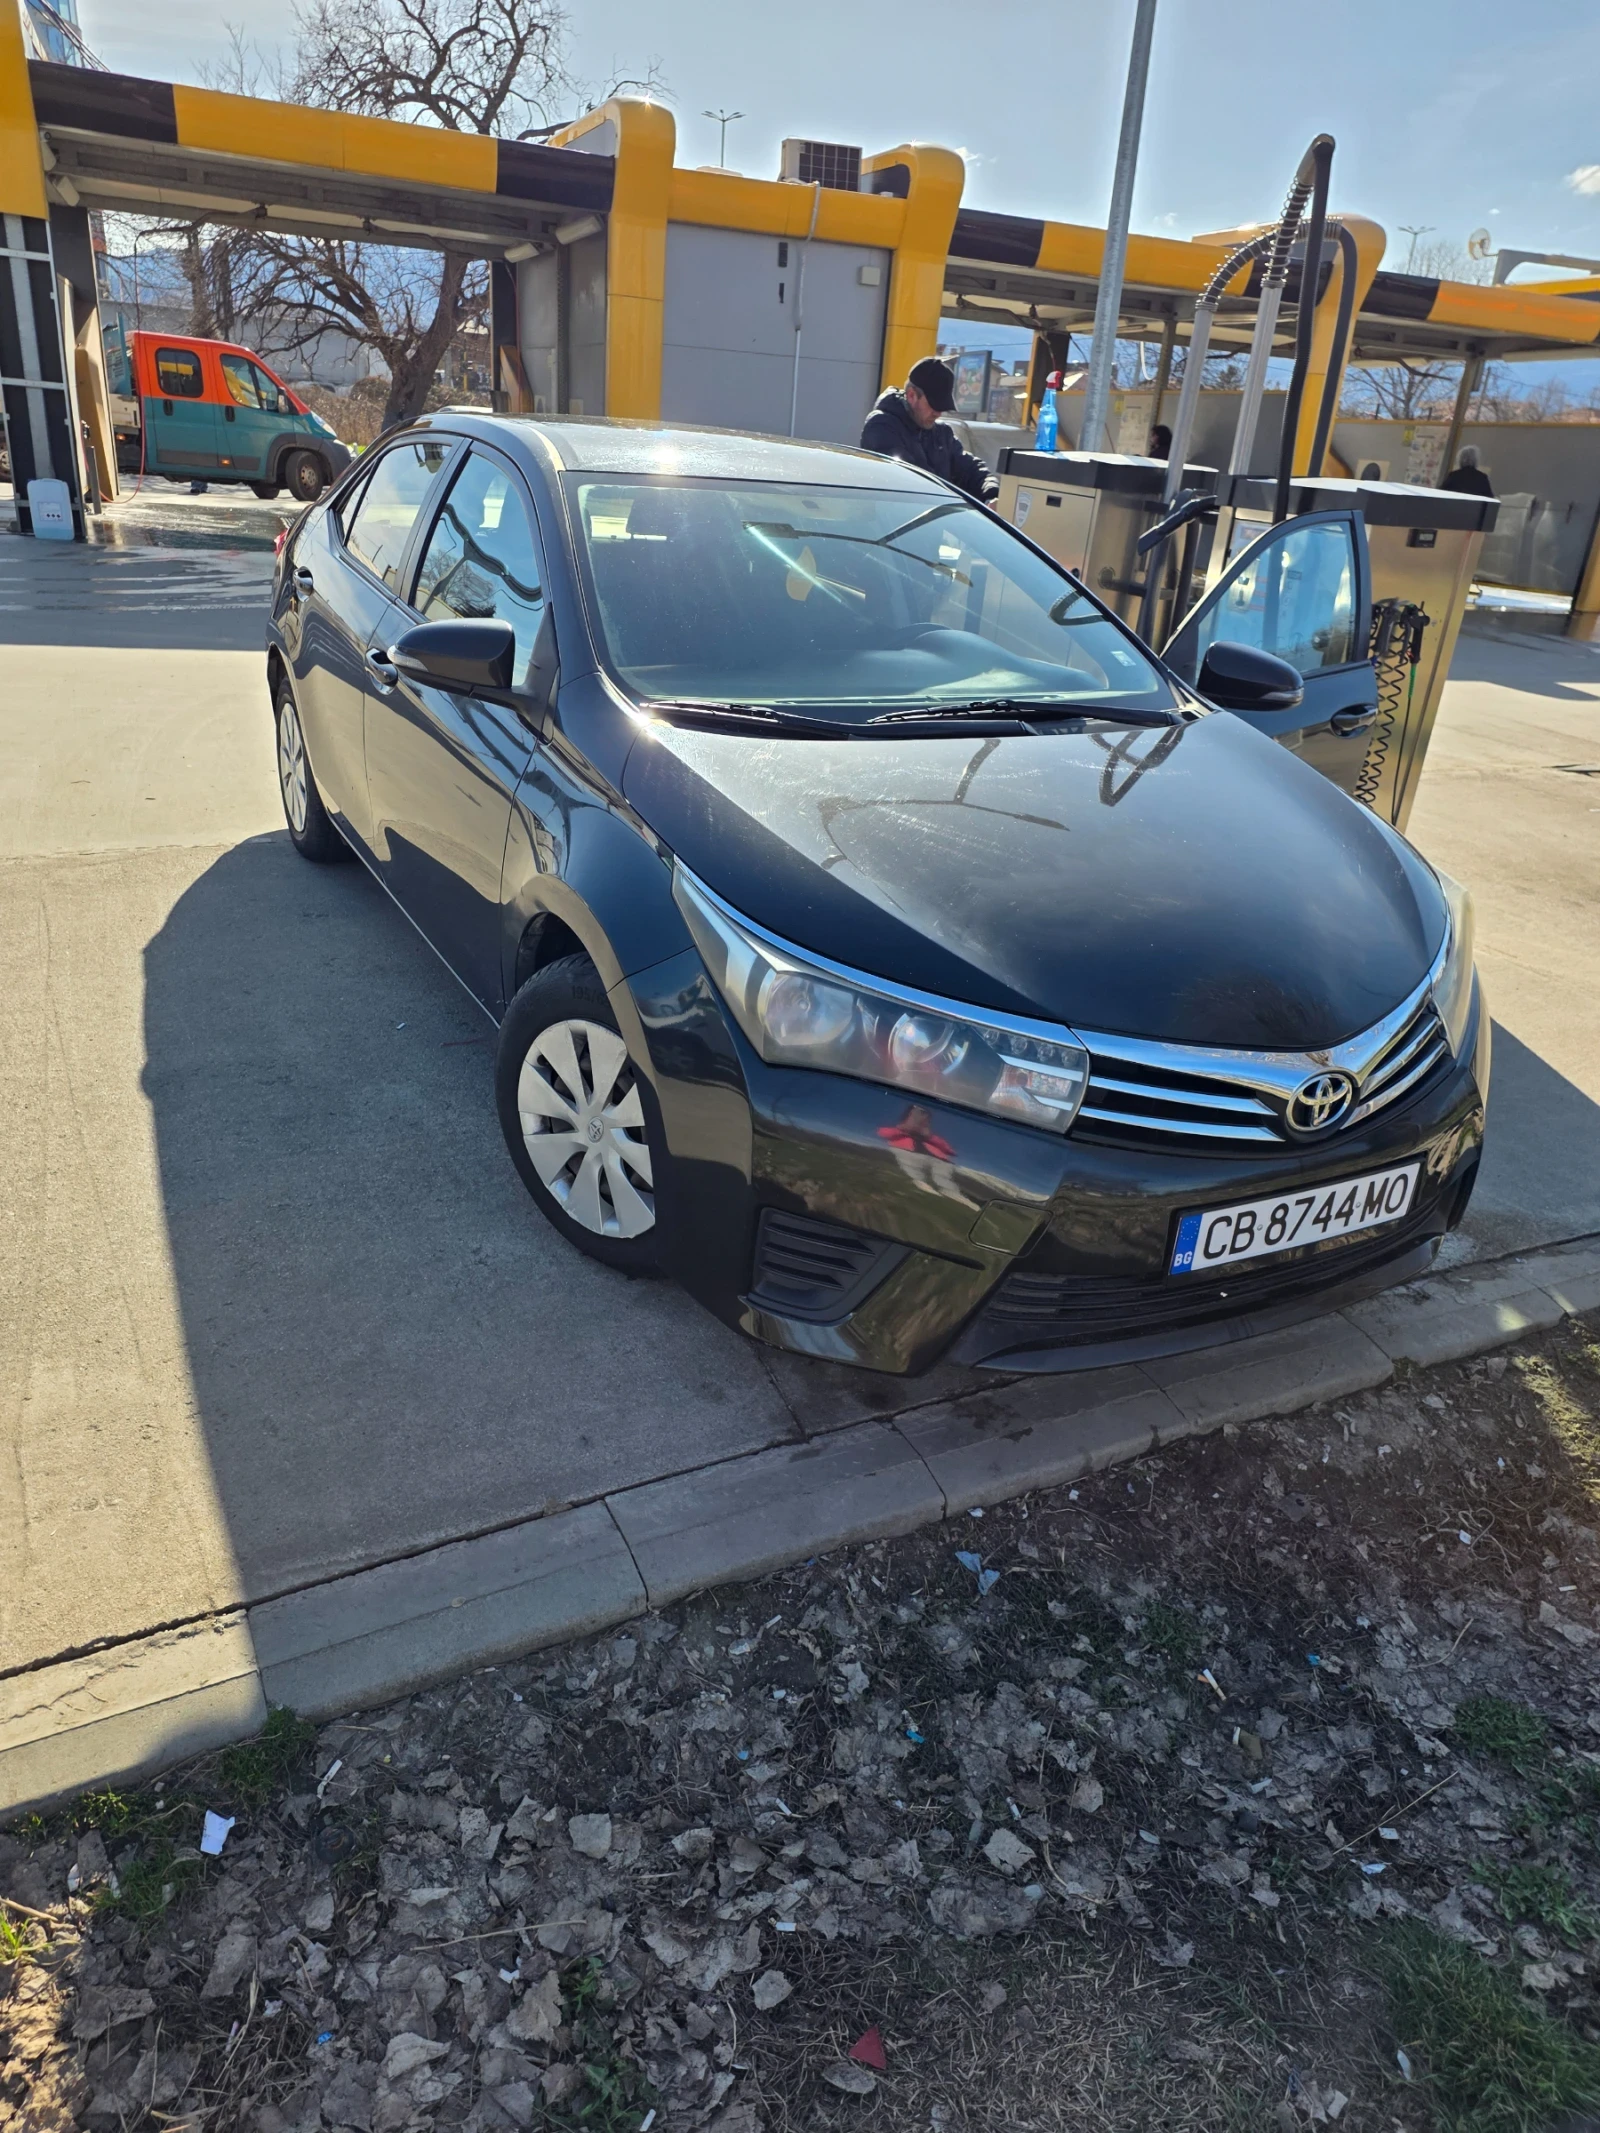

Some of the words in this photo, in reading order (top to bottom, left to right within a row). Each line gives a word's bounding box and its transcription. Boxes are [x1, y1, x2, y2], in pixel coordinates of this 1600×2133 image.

[1203, 1210, 1257, 1260] CB
[1264, 1185, 1359, 1246] 8744
[1360, 1173, 1409, 1223] MO
[1173, 1251, 1193, 1267] BG
